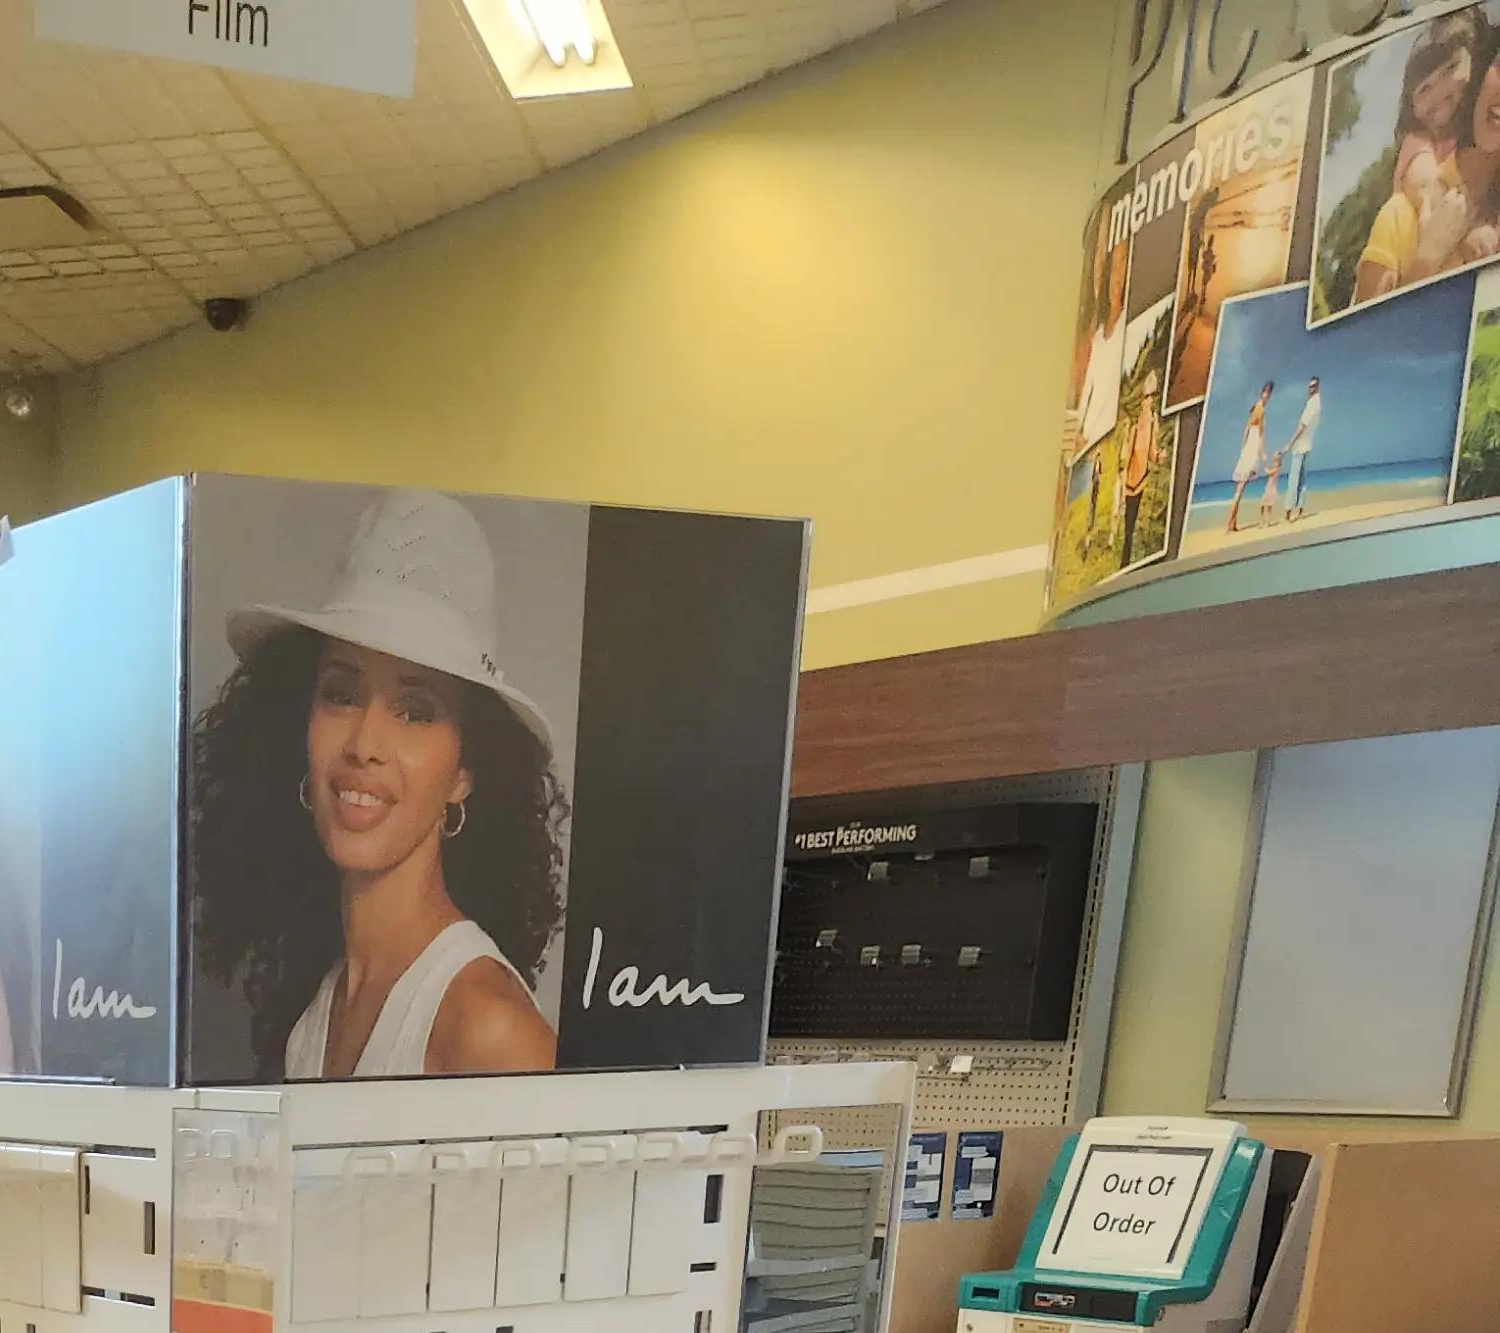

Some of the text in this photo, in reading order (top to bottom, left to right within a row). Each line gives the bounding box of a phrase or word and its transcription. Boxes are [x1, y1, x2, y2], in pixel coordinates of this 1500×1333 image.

[1107, 102, 1293, 253] memories
[807, 831, 835, 849] BEST
[836, 824, 917, 846] PERFORMING
[1103, 1173, 1177, 1197] Out Of
[1093, 1211, 1156, 1235] Order
